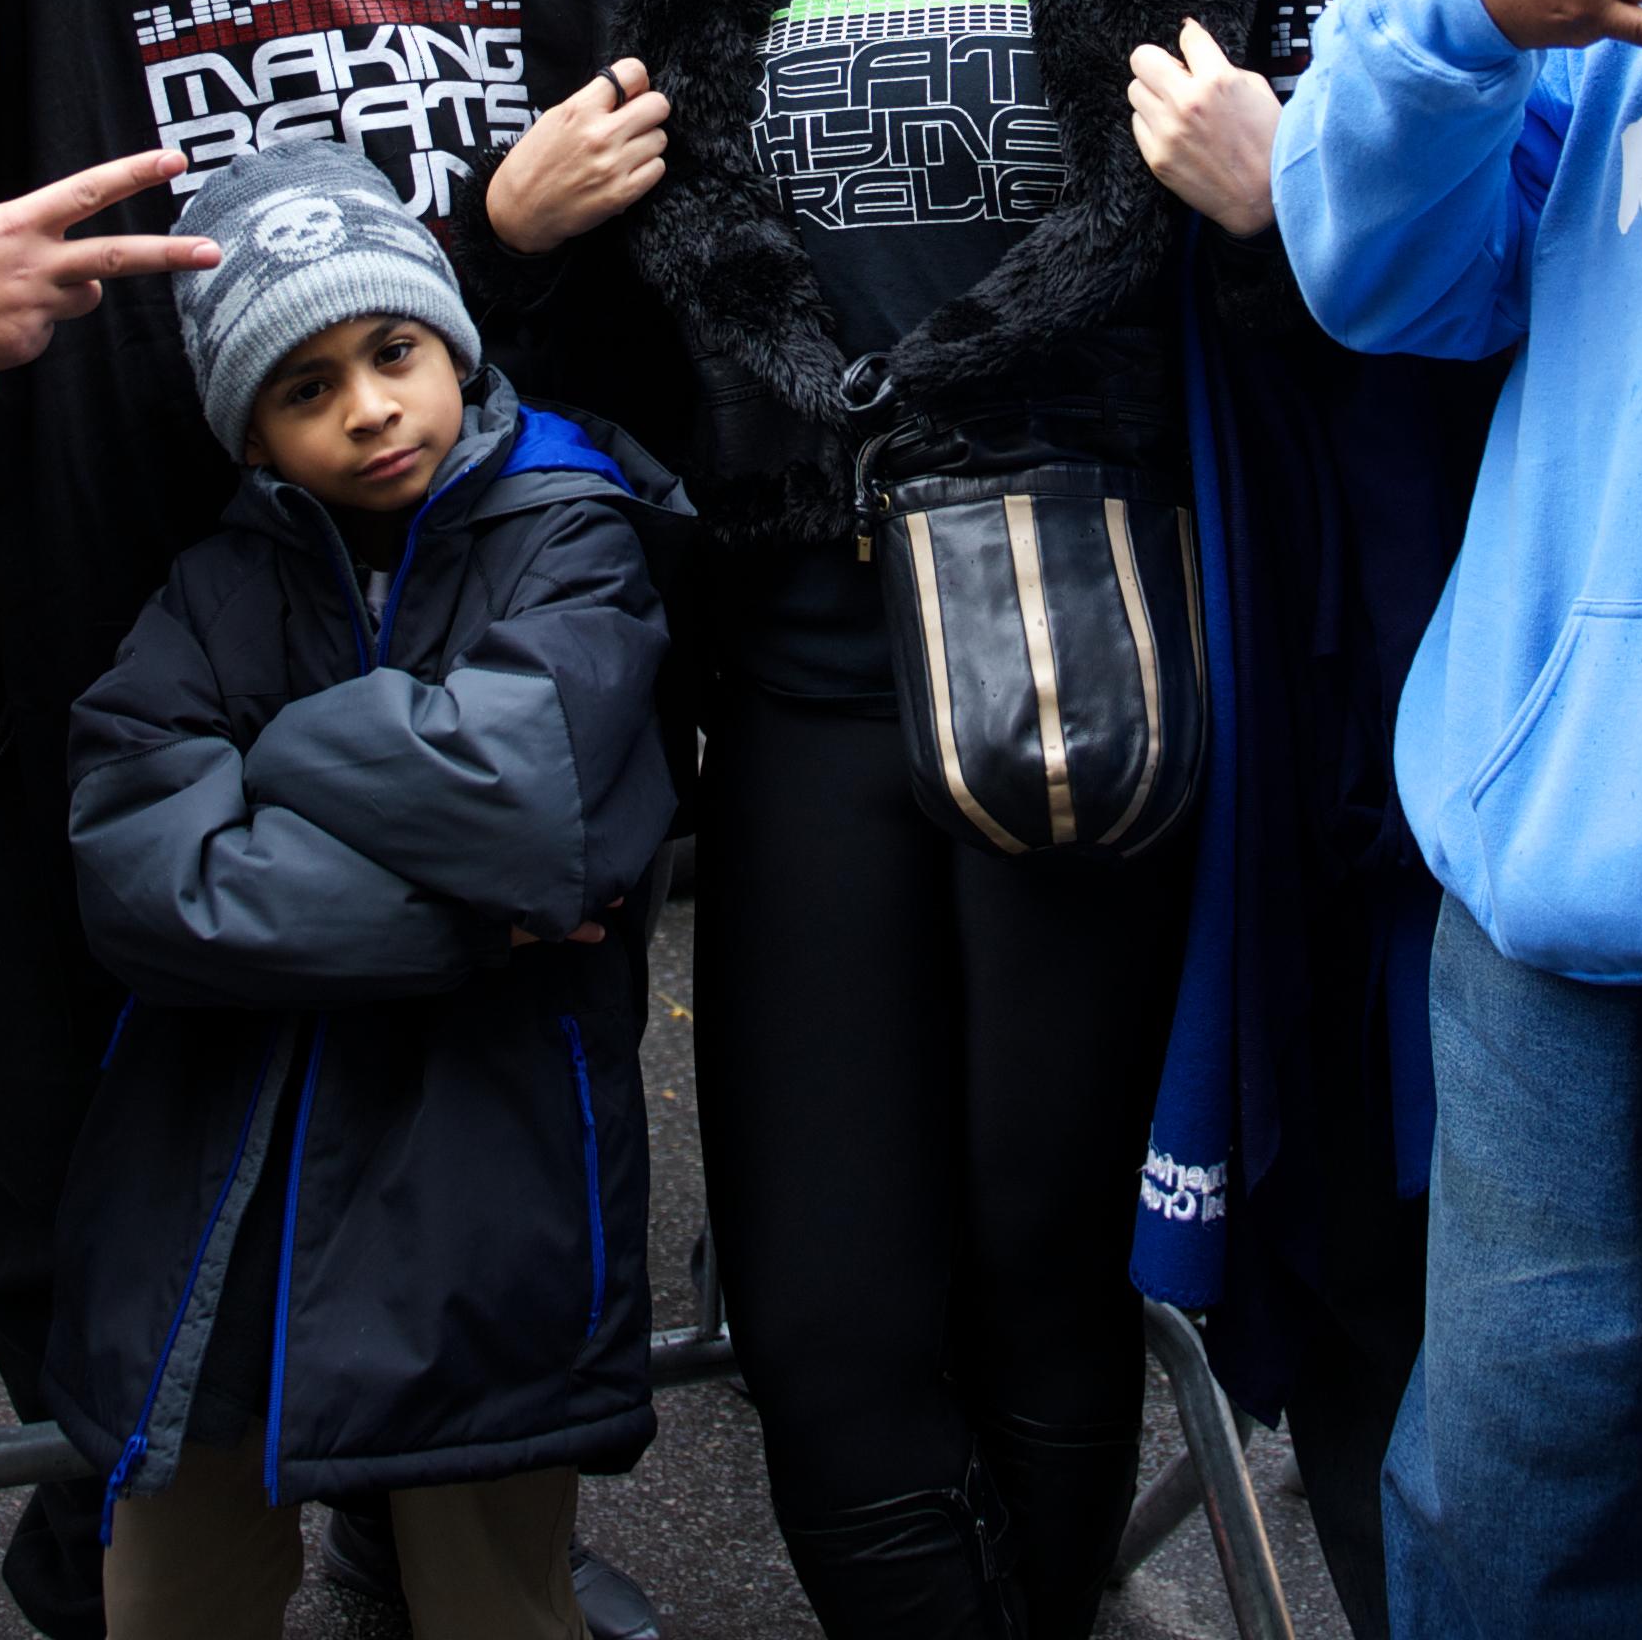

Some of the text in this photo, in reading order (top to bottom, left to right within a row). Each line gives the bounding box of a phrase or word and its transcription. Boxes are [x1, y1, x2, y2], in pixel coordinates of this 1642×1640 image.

[144, 25, 525, 125] MAKING
[158, 81, 537, 195] BEATS
[750, 104, 1063, 175] HYME
[776, 164, 1068, 230] RELIE
